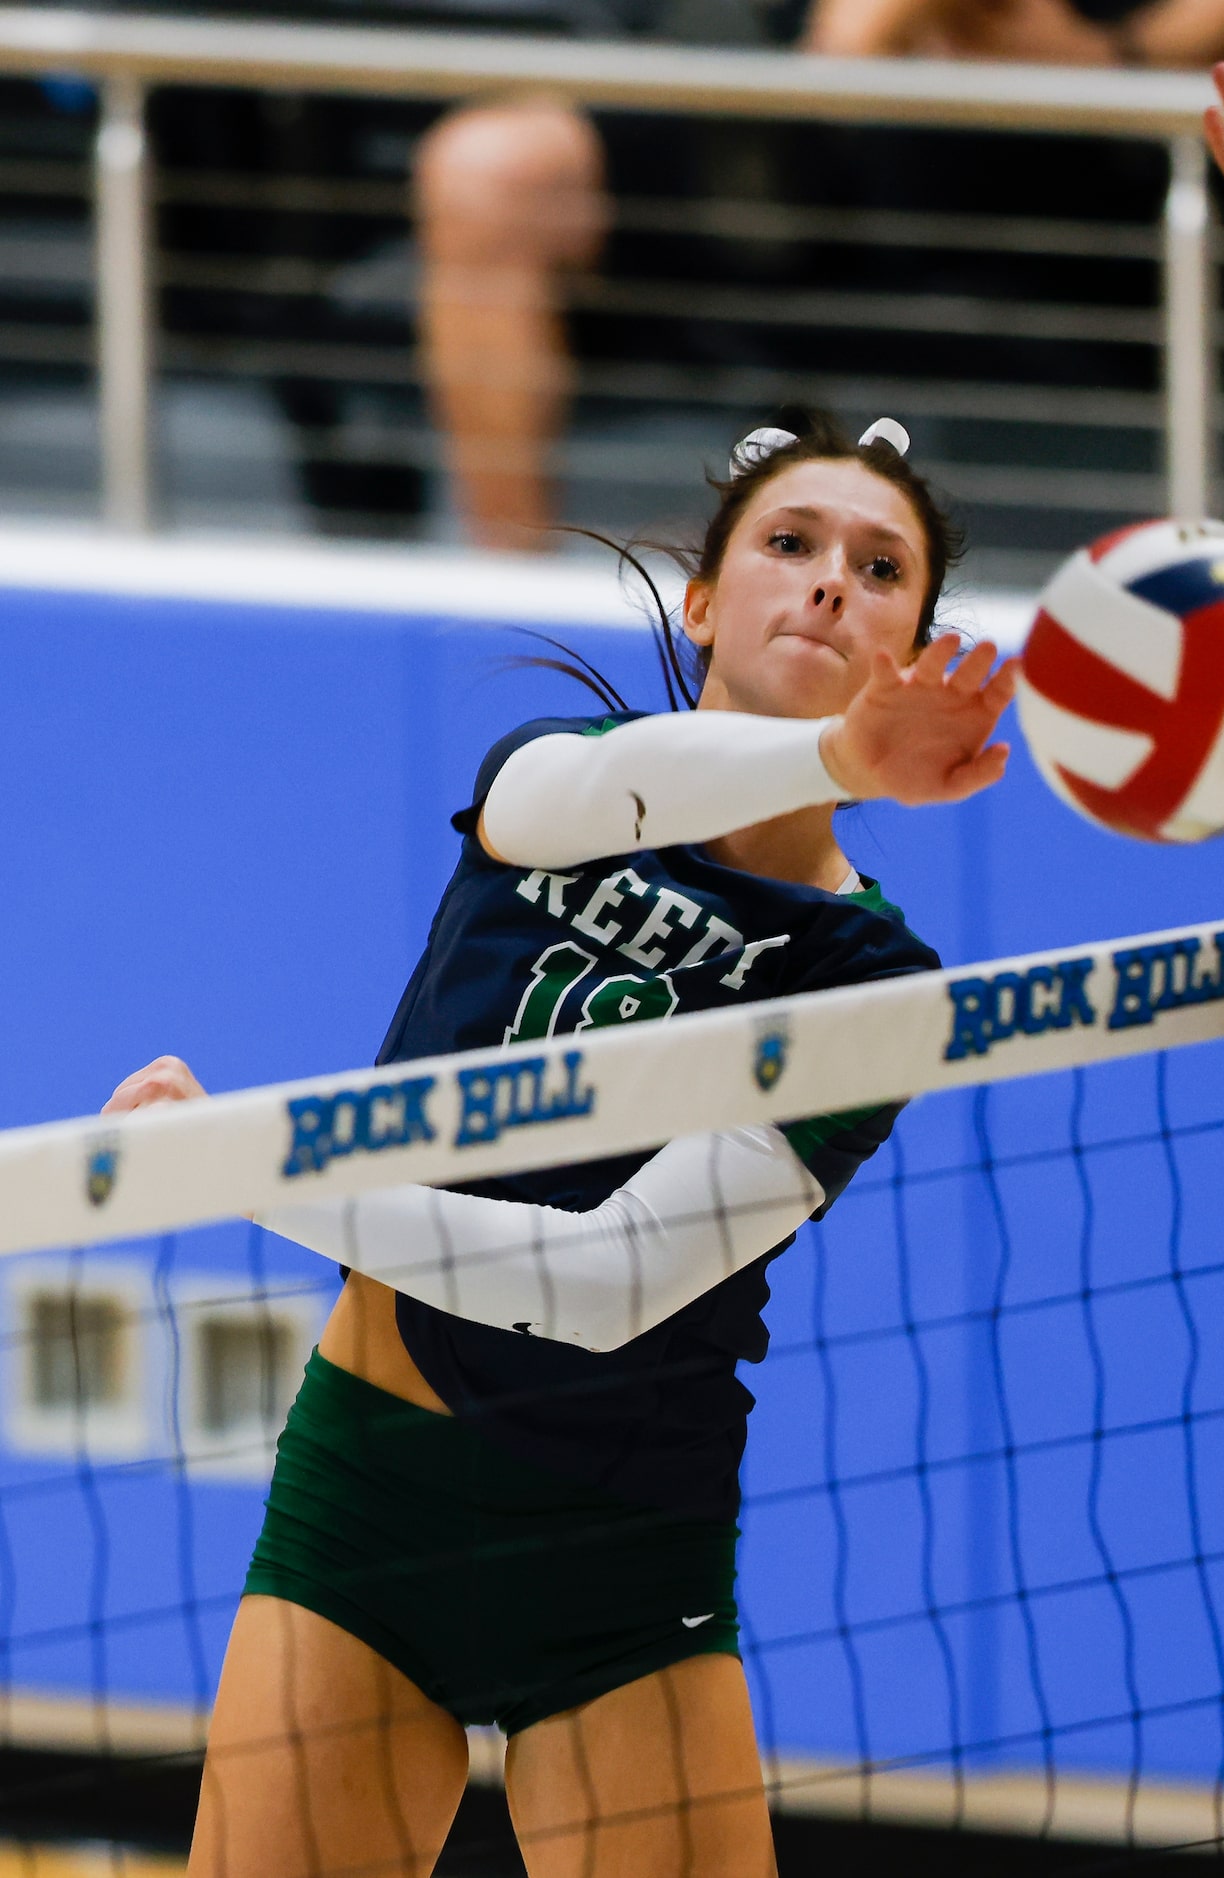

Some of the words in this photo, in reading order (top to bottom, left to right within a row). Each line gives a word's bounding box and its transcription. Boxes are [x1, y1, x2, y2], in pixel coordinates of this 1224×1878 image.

[943, 957, 1096, 1062] ROCK
[281, 1074, 438, 1179] ROCK
[453, 1050, 597, 1149] HILL
